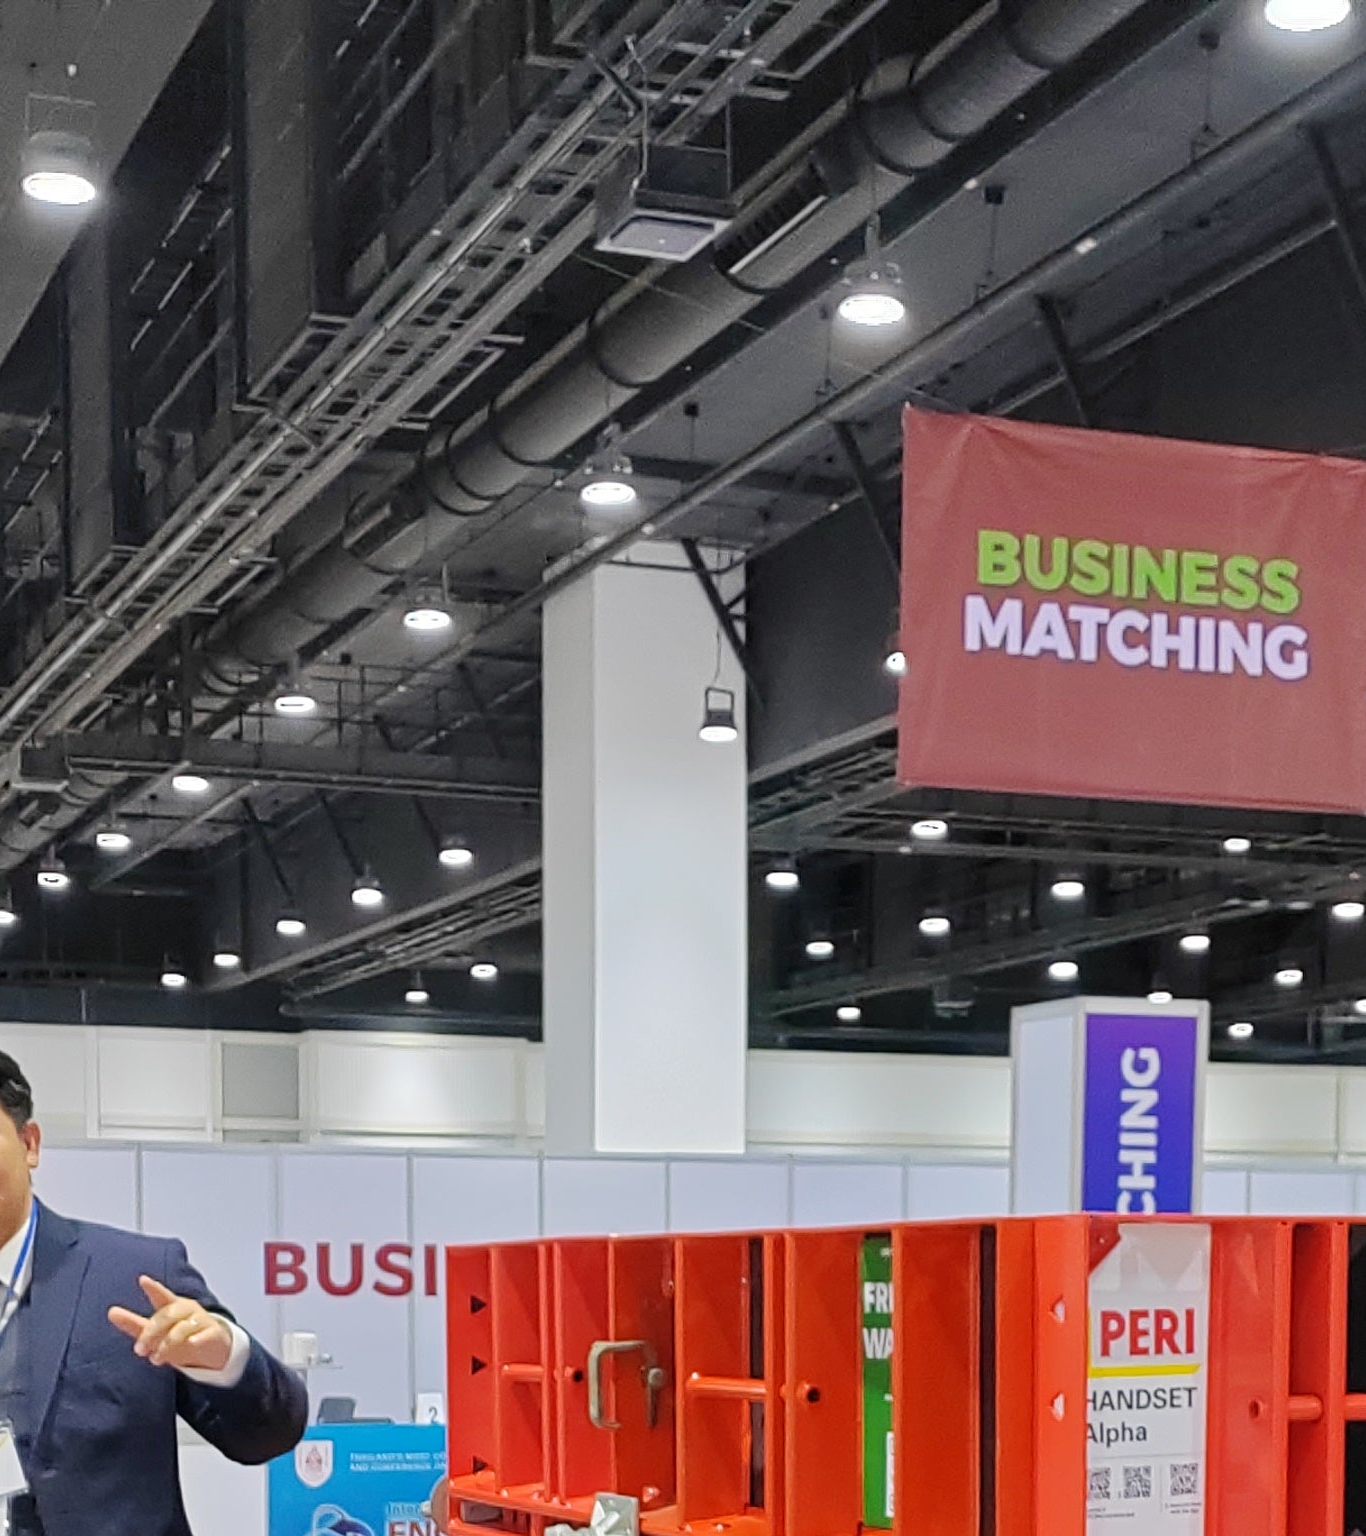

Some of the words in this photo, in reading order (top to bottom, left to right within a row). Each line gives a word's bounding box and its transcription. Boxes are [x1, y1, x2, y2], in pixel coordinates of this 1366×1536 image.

[976, 529, 1301, 614] BUSINESS
[963, 594, 1310, 681] MATCHING
[263, 1241, 438, 1297] BUSI
[1100, 1308, 1195, 1357] PERI
